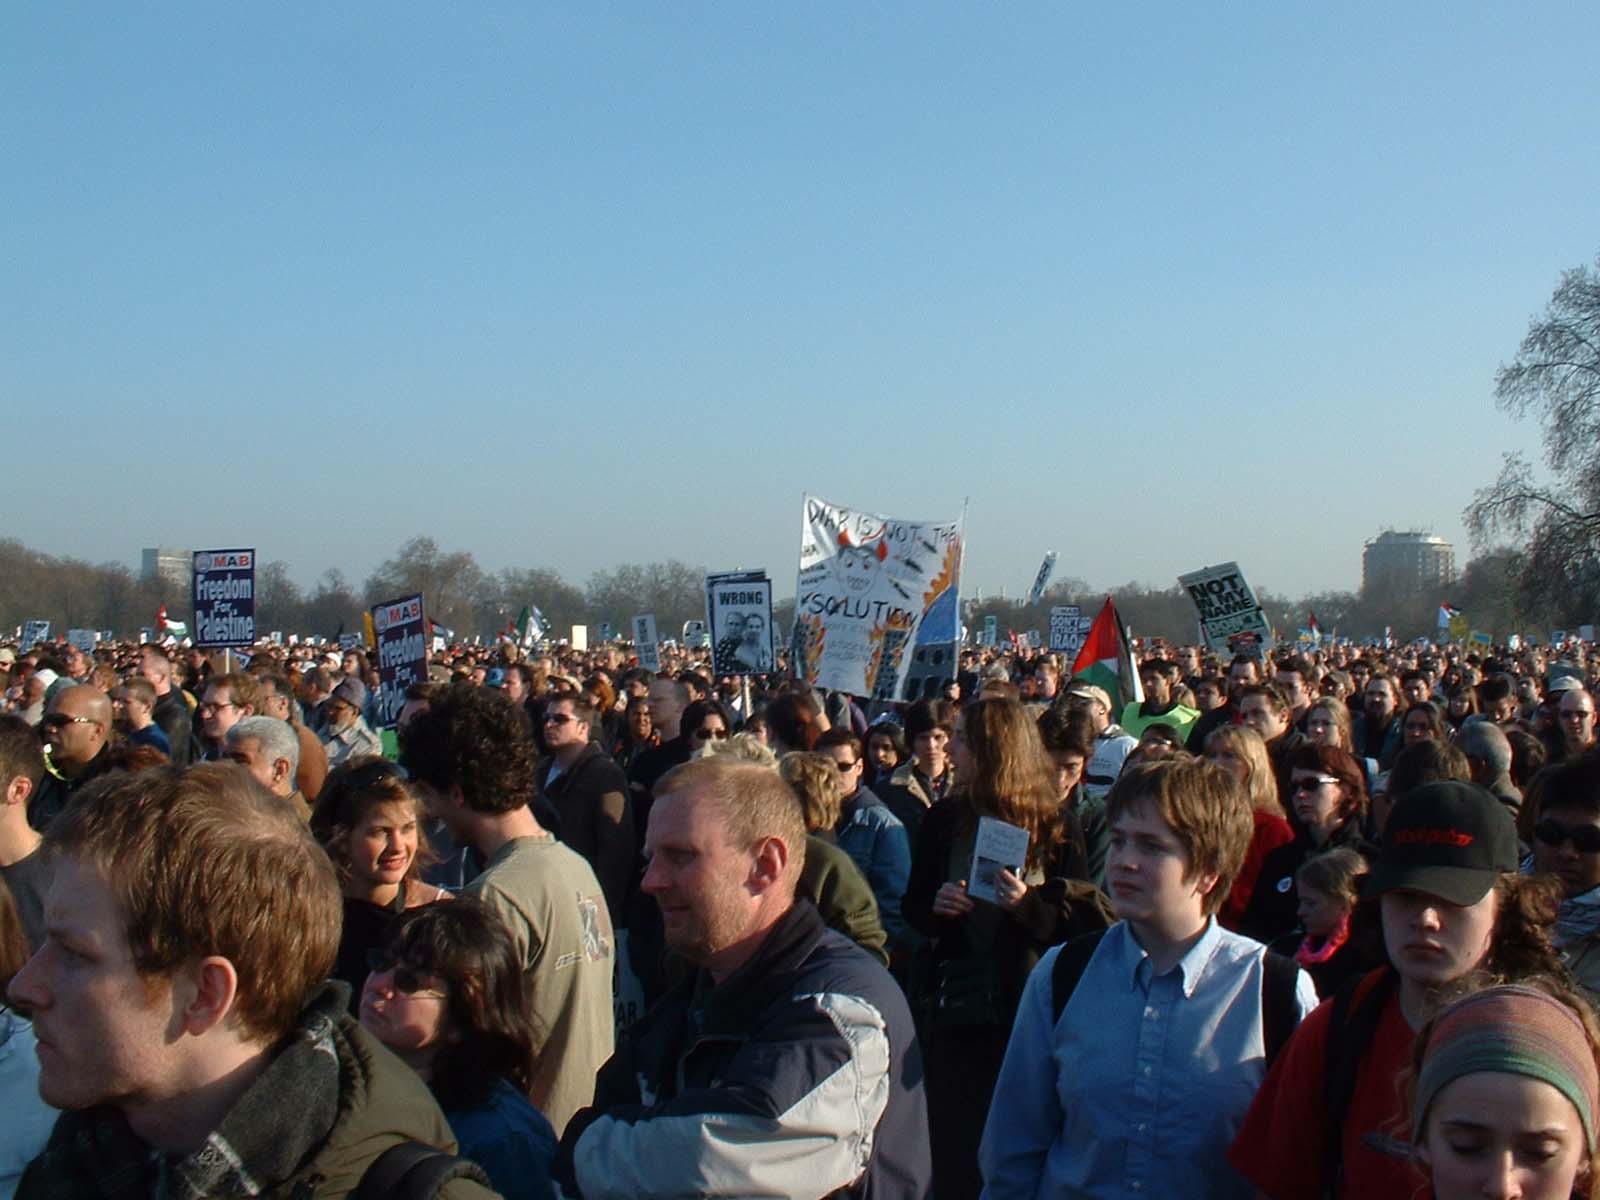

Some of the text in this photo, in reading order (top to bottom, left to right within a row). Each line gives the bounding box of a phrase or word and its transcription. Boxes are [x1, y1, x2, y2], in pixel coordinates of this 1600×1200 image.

[855, 515, 873, 536] IS
[881, 523, 922, 544] NOT
[932, 524, 956, 545] THE
[214, 555, 249, 567] MAB
[196, 573, 252, 600] Freedom
[719, 591, 764, 605] WRONG
[1188, 574, 1238, 600] NOT
[1216, 587, 1245, 606] MY
[214, 600, 233, 612] For
[389, 603, 420, 620] MAB
[808, 592, 918, 627] SOLUTION
[1200, 598, 1256, 618] NAME
[195, 608, 254, 640] Palestine
[377, 628, 425, 668] Freedom
[613, 1001, 637, 1026] AR
